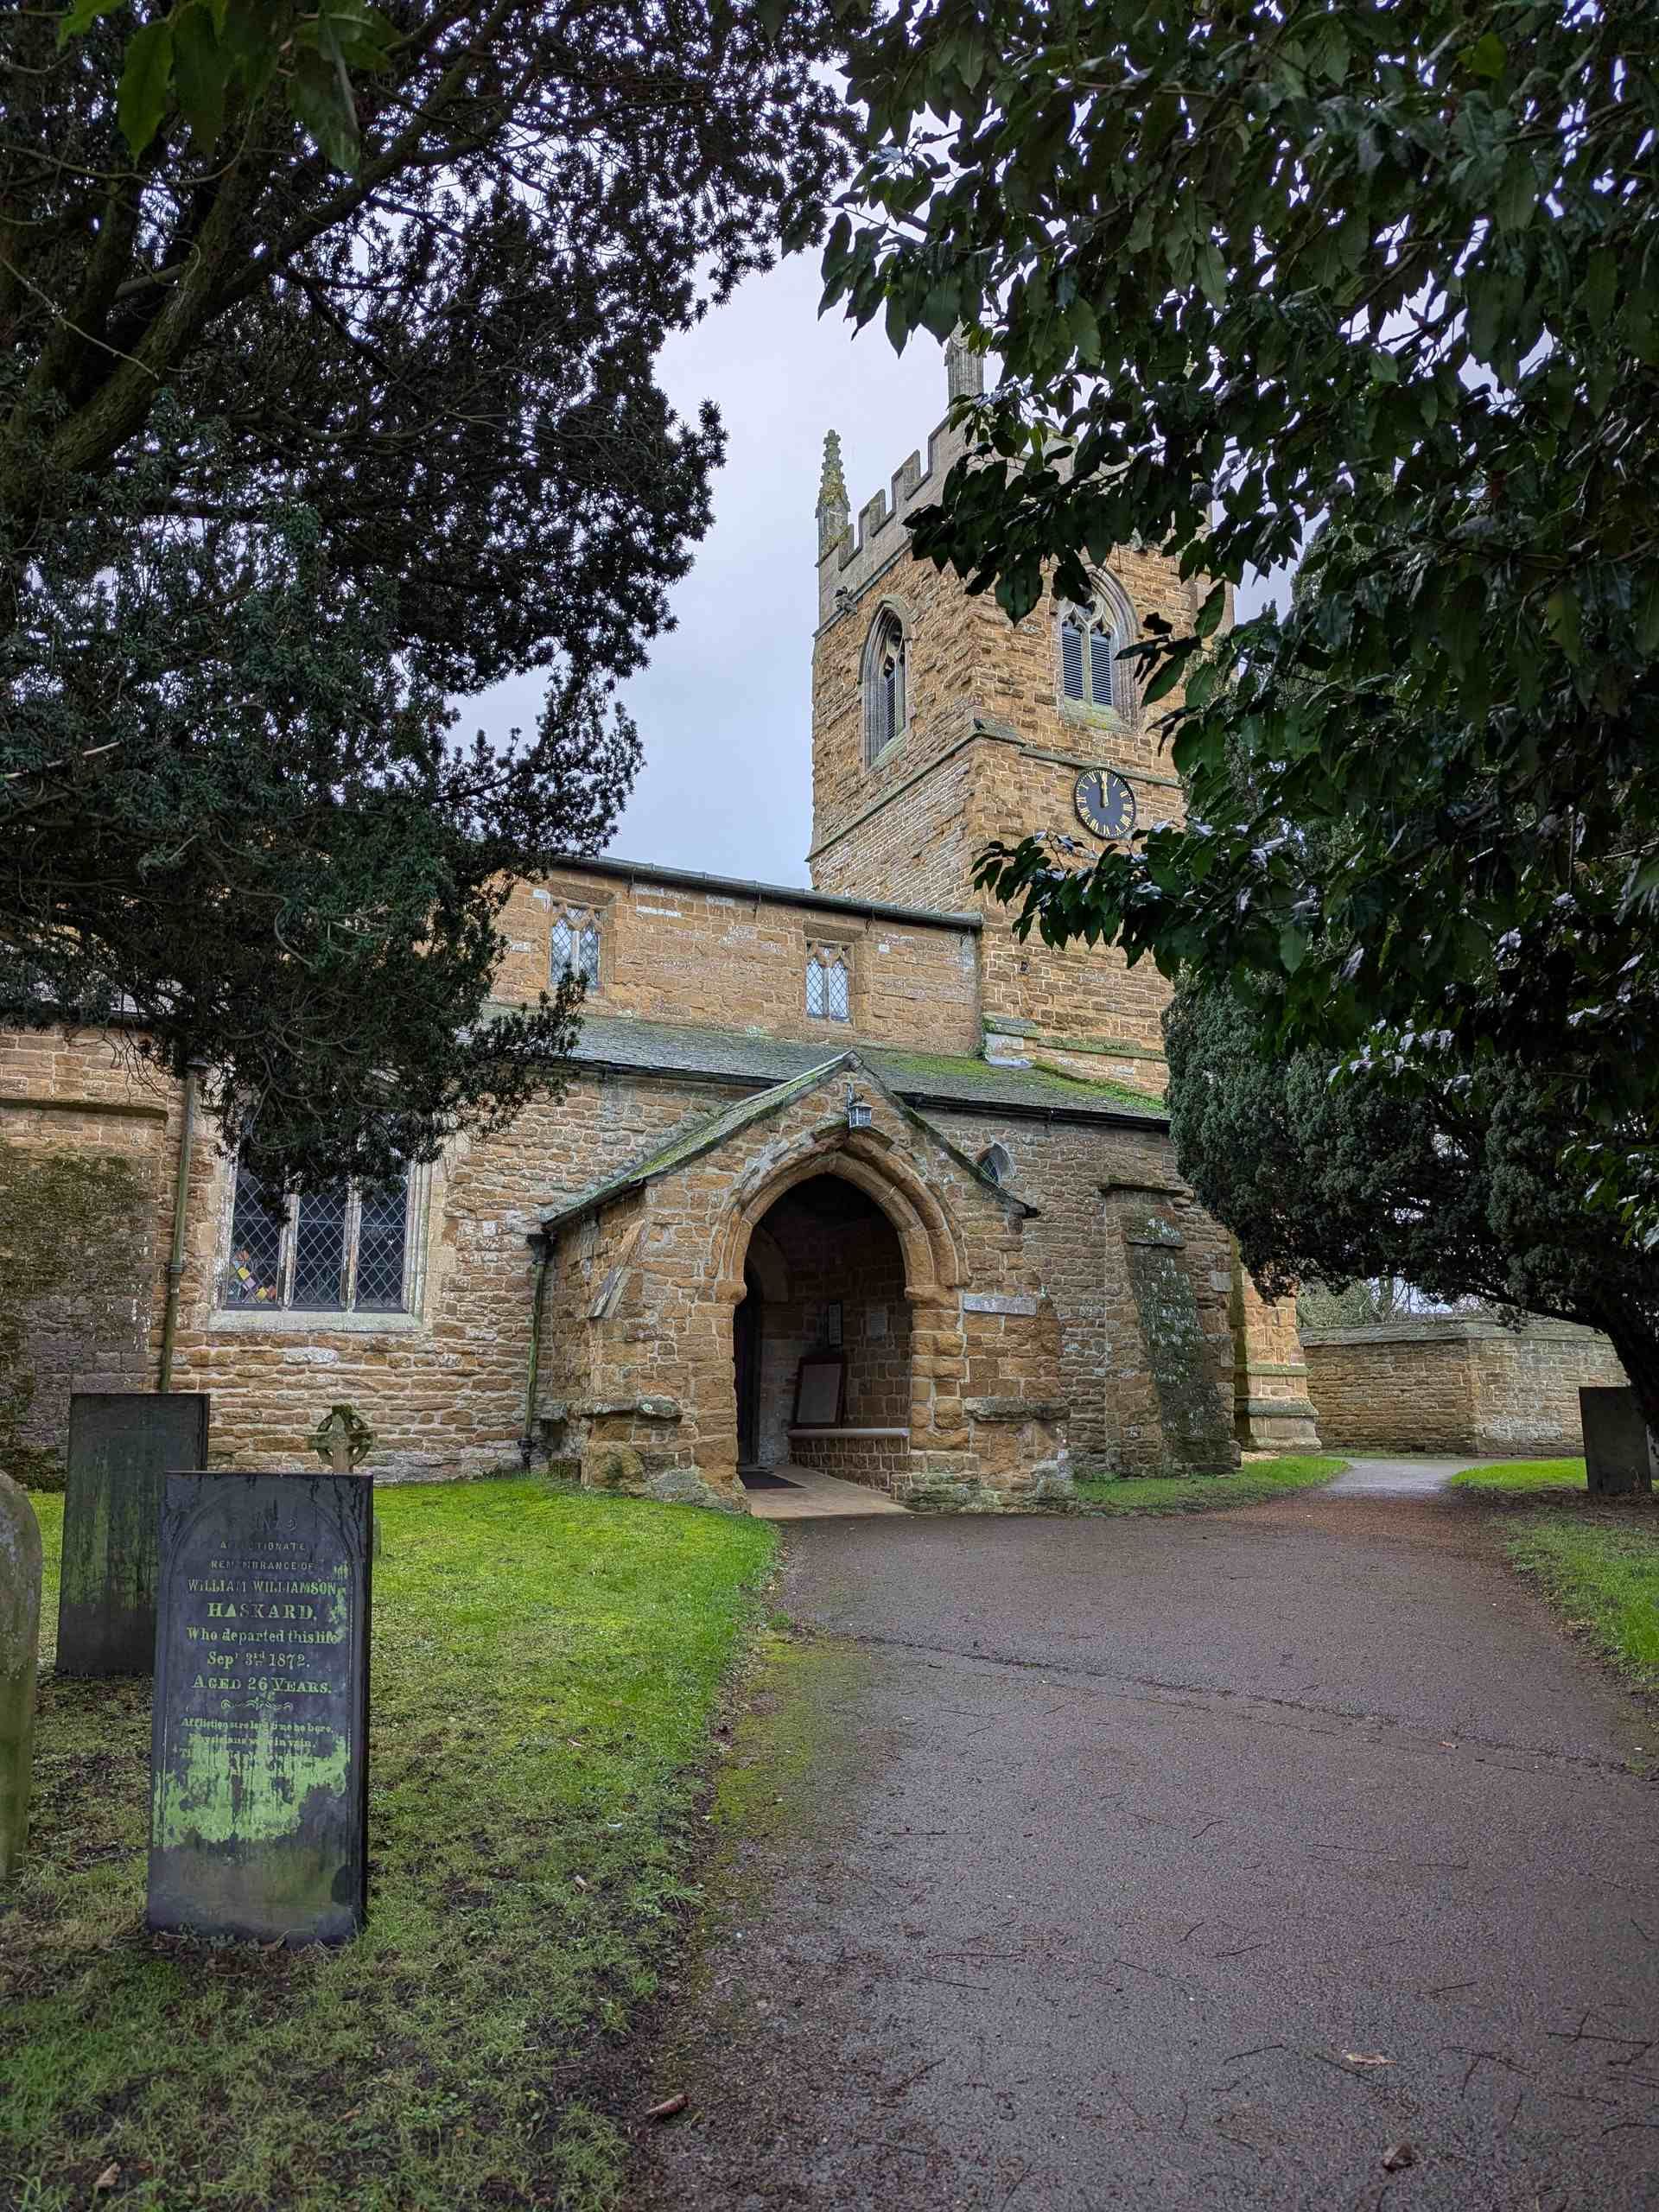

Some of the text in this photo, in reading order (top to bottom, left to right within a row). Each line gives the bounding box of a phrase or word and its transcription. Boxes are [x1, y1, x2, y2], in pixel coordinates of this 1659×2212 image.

[186, 1625, 217, 1641] Who
[221, 1628, 284, 1645] departed
[289, 1630, 314, 1643] this
[191, 1674, 333, 1694] AGED 26 YEARS.
